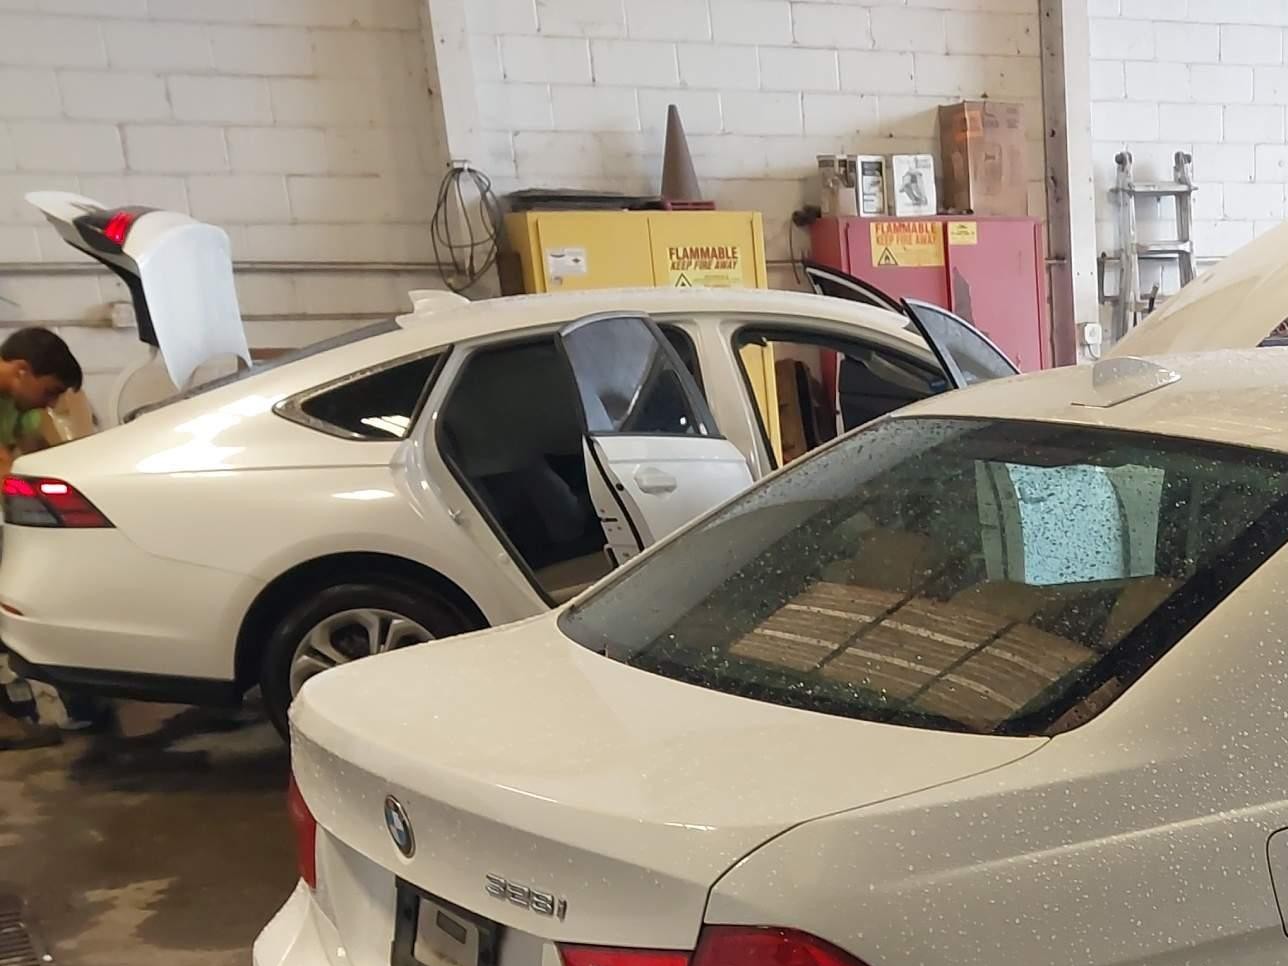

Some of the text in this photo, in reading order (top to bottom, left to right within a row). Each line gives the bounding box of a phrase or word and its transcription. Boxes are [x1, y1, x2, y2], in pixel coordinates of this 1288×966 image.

[875, 223, 936, 234] FLAMMABLE
[668, 246, 738, 260] FLAMMABLE
[670, 260, 737, 270] KEEP FIRE AWAY
[485, 872, 568, 922] 328i
